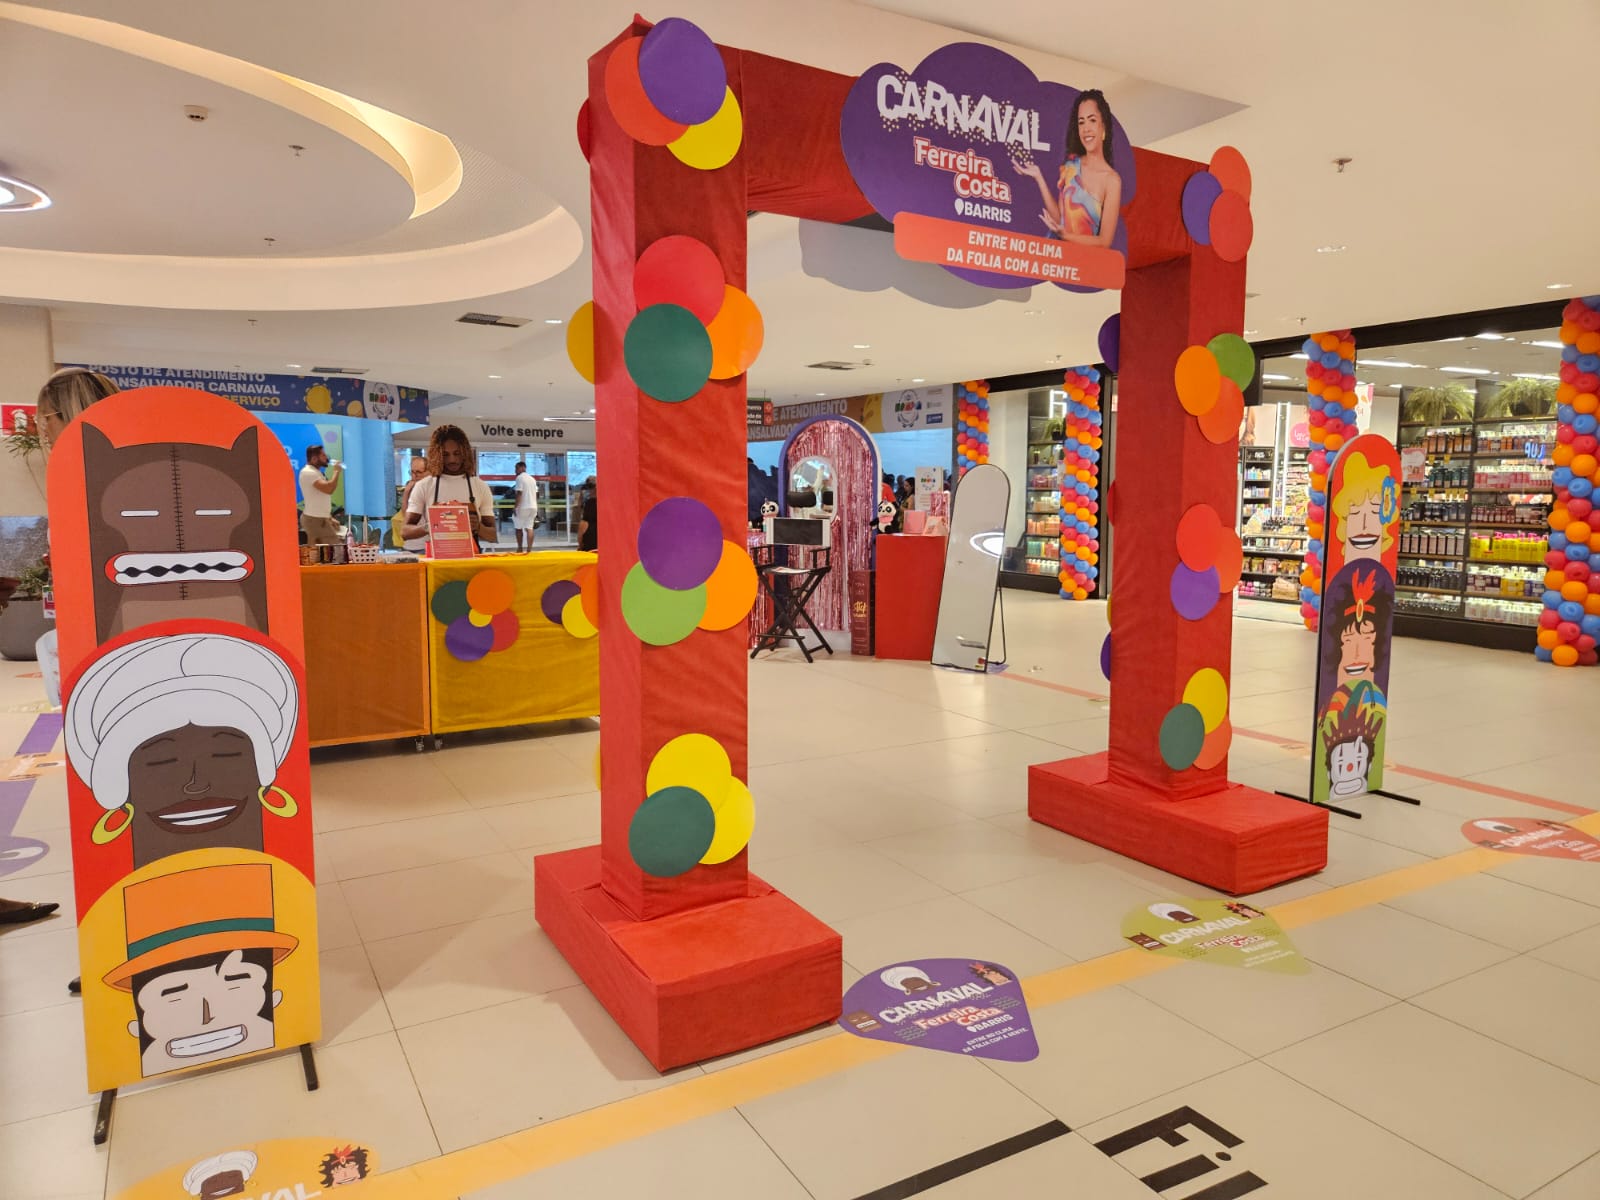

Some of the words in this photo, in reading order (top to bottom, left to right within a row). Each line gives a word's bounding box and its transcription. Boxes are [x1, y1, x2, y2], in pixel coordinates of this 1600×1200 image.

[877, 74, 1051, 152] CARNAVAL
[914, 137, 993, 177] Ferreira
[955, 173, 1011, 204] Costa
[964, 201, 1012, 223] BARRIS
[968, 231, 1007, 250] ENTRE
[1010, 236, 1026, 253] NO
[1028, 241, 1062, 259] CLIMA
[947, 247, 963, 263] DA
[967, 251, 1001, 268] FOLIA
[1005, 257, 1029, 273] COM
[1031, 262, 1039, 274] A
[1042, 263, 1080, 281] GENTE.
[143, 367, 162, 377] DE
[166, 369, 266, 382] ATENDIMENTO
[208, 382, 281, 394] CARNAVAL
[780, 399, 848, 420] ATENDIMENTO
[481, 424, 514, 437] Volte
[517, 428, 564, 439] sempre
[1159, 917, 1250, 945] CARNAVAL
[879, 982, 994, 1023] CARNAVAL
[914, 1006, 978, 1029] Ferreira
[956, 1007, 1004, 1026] Costa
[975, 1014, 1014, 1032] BARRIS
